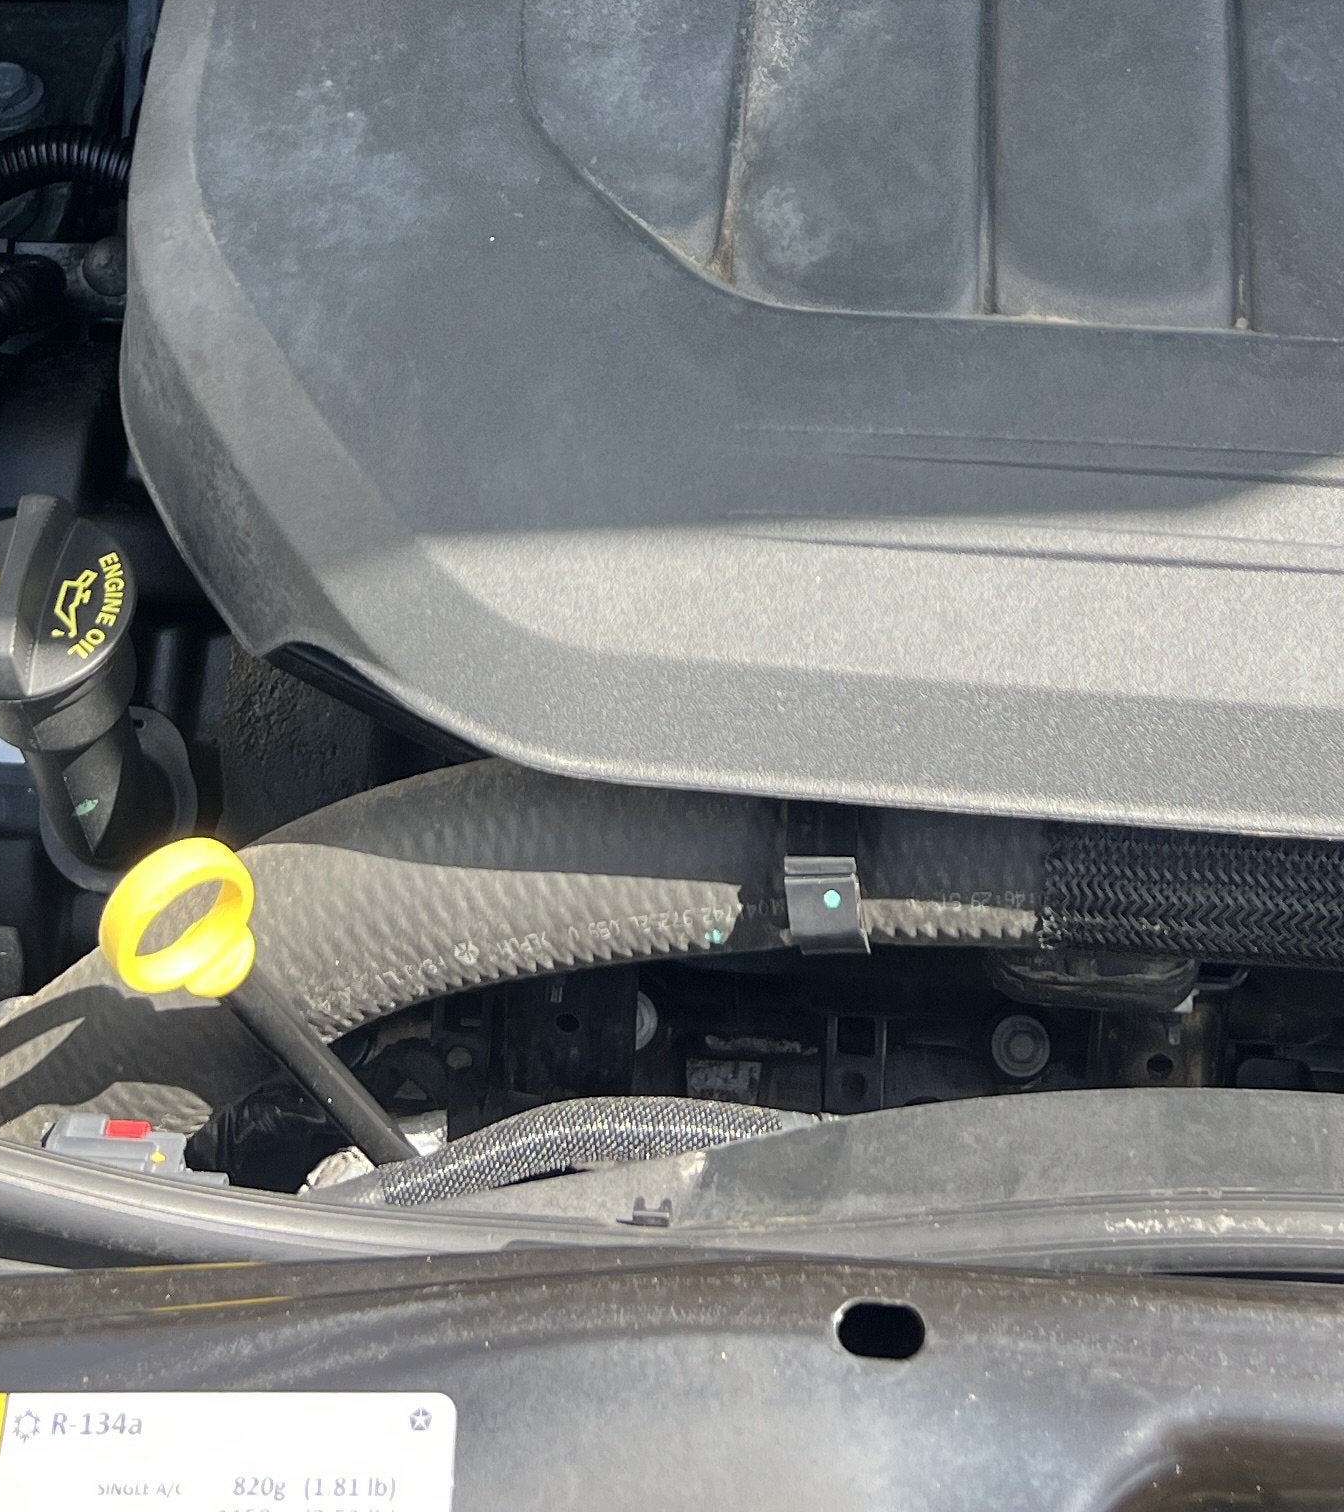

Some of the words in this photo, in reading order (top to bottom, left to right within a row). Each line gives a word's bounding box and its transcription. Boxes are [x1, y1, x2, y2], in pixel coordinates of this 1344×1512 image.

[95, 551, 126, 628] ENGINE
[67, 627, 107, 660] OIL
[50, 1411, 143, 1437] R-134a
[97, 1481, 152, 1497] SINGLE
[233, 1476, 287, 1501] 820g
[367, 1476, 397, 1502] lb)
